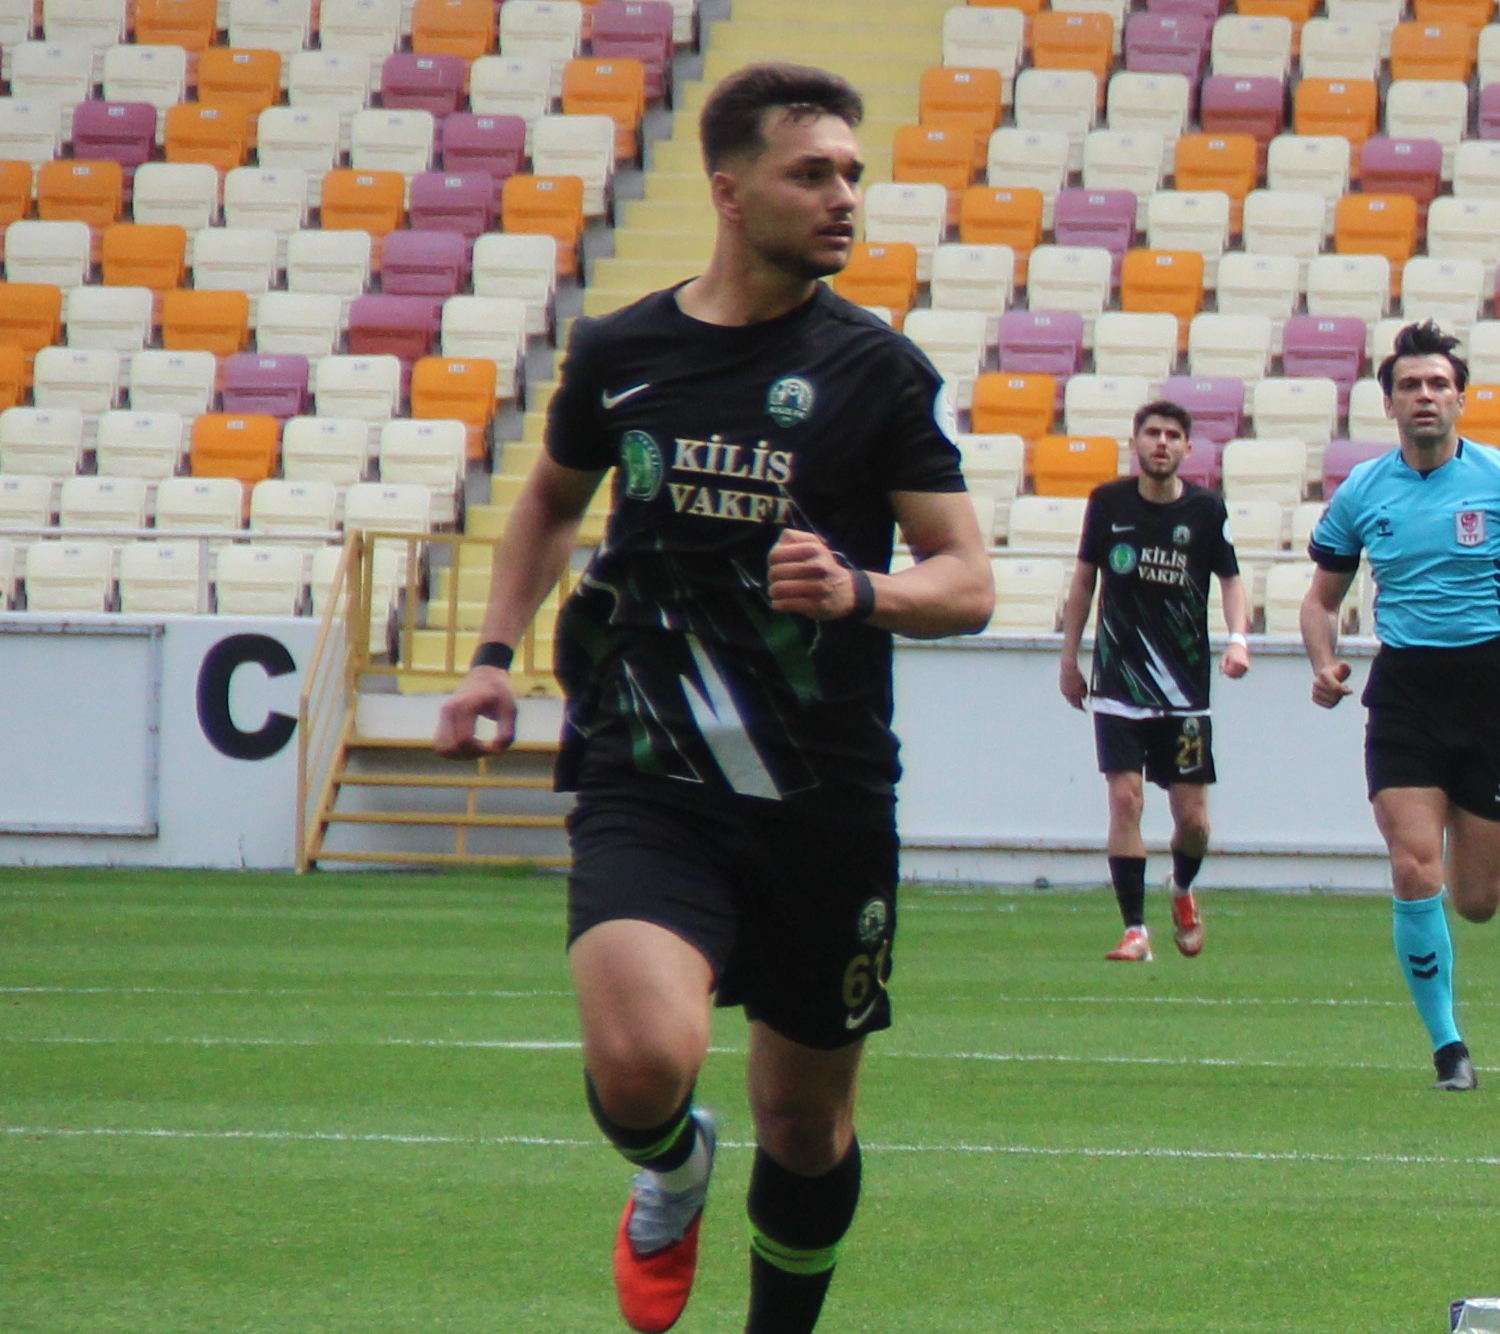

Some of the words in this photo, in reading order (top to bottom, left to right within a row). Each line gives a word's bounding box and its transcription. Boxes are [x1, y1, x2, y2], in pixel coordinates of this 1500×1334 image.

[671, 433, 794, 485] KİLİS
[666, 482, 797, 525] VAKFI
[196, 633, 298, 761] C
[1175, 734, 1204, 766] 21
